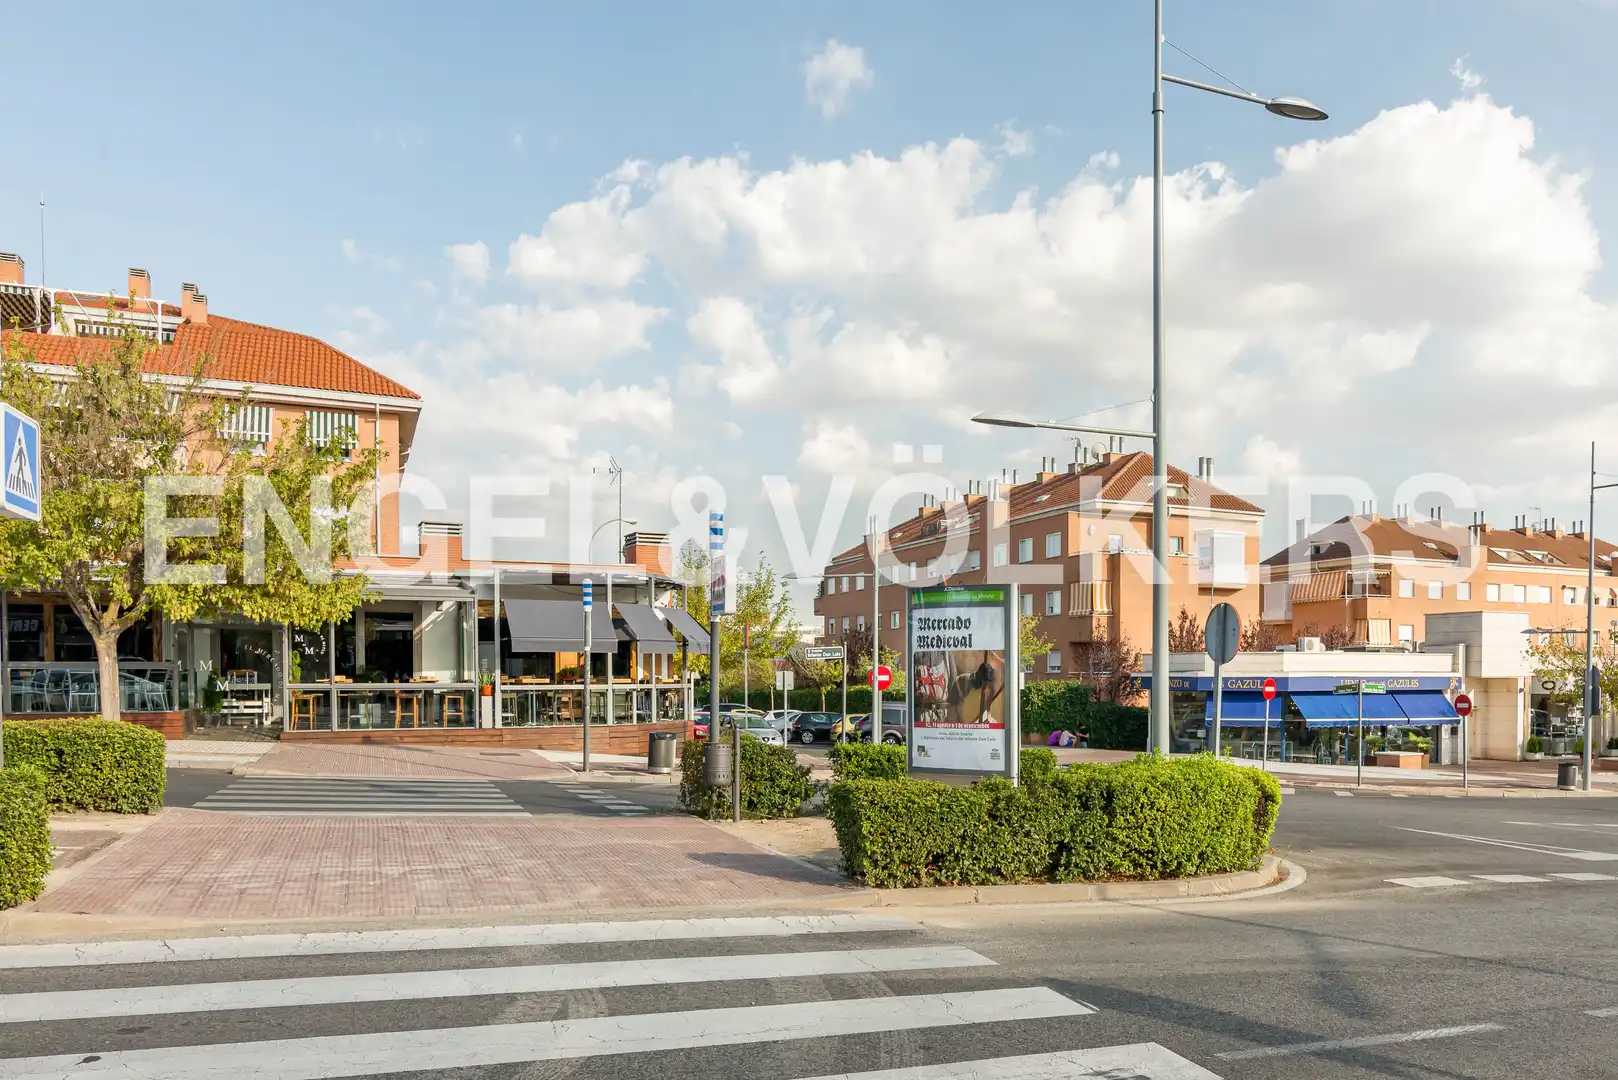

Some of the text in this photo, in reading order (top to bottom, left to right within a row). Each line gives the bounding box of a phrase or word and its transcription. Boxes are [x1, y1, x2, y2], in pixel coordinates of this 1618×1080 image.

[917, 616, 972, 631] Mercado
[916, 633, 973, 649] Medieval
[199, 660, 213, 671] M
[216, 680, 229, 692] M
[1227, 679, 1266, 689] GAZUL
[1387, 679, 1419, 688] GAZULES
